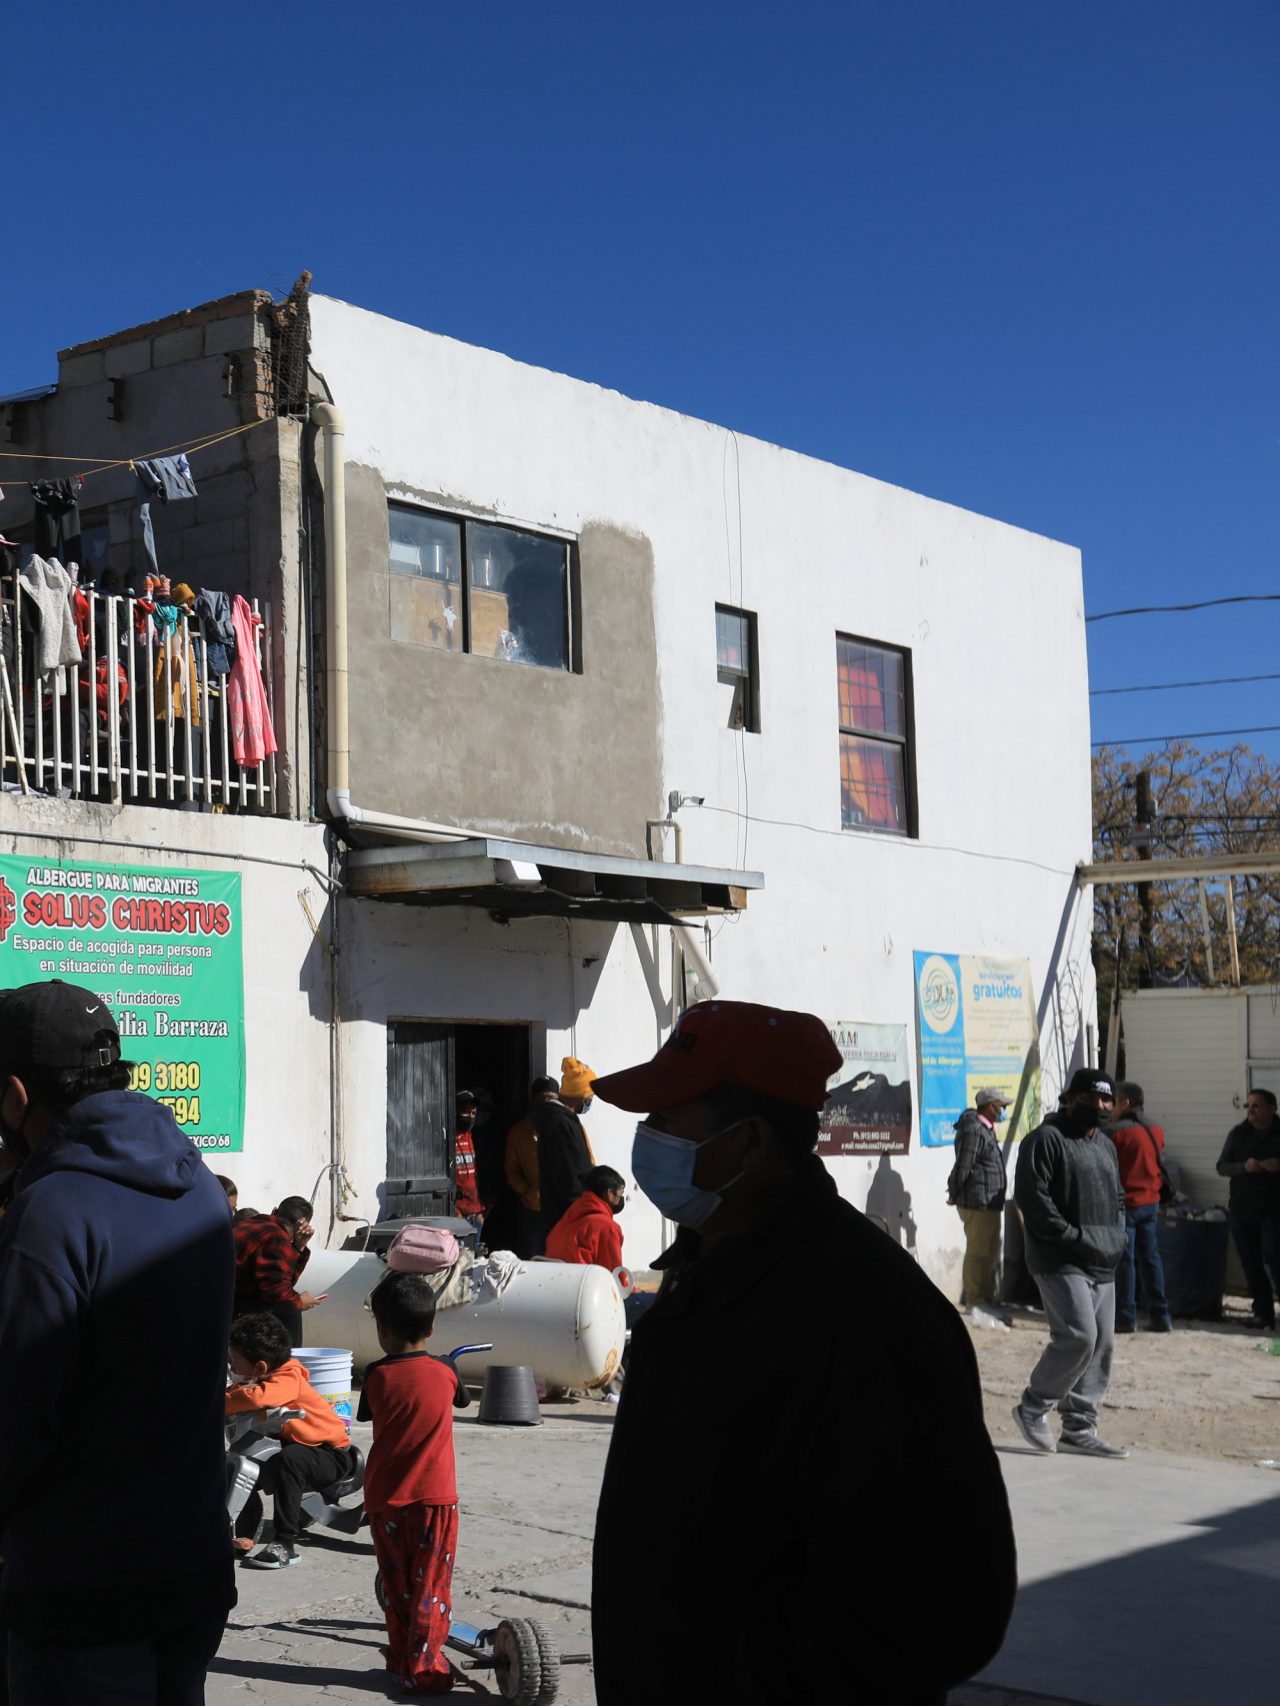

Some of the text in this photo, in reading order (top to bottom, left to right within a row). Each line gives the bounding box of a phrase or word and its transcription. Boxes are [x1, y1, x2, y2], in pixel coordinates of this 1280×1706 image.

[26, 867, 200, 897] ALBERGUE PARA MIGRANTES
[23, 891, 231, 936] SOLUS CHRISTUS
[13, 935, 213, 958] Espacio de acogida para persona
[40, 958, 194, 977] en situación de movilidad
[116, 990, 181, 1006] fundadores
[973, 981, 1023, 1002] gratuitos
[110, 1010, 229, 1038] ilia Barraza
[154, 1062, 201, 1091] 3180
[157, 1096, 201, 1125] 94
[218, 1134, 231, 1147] 68
